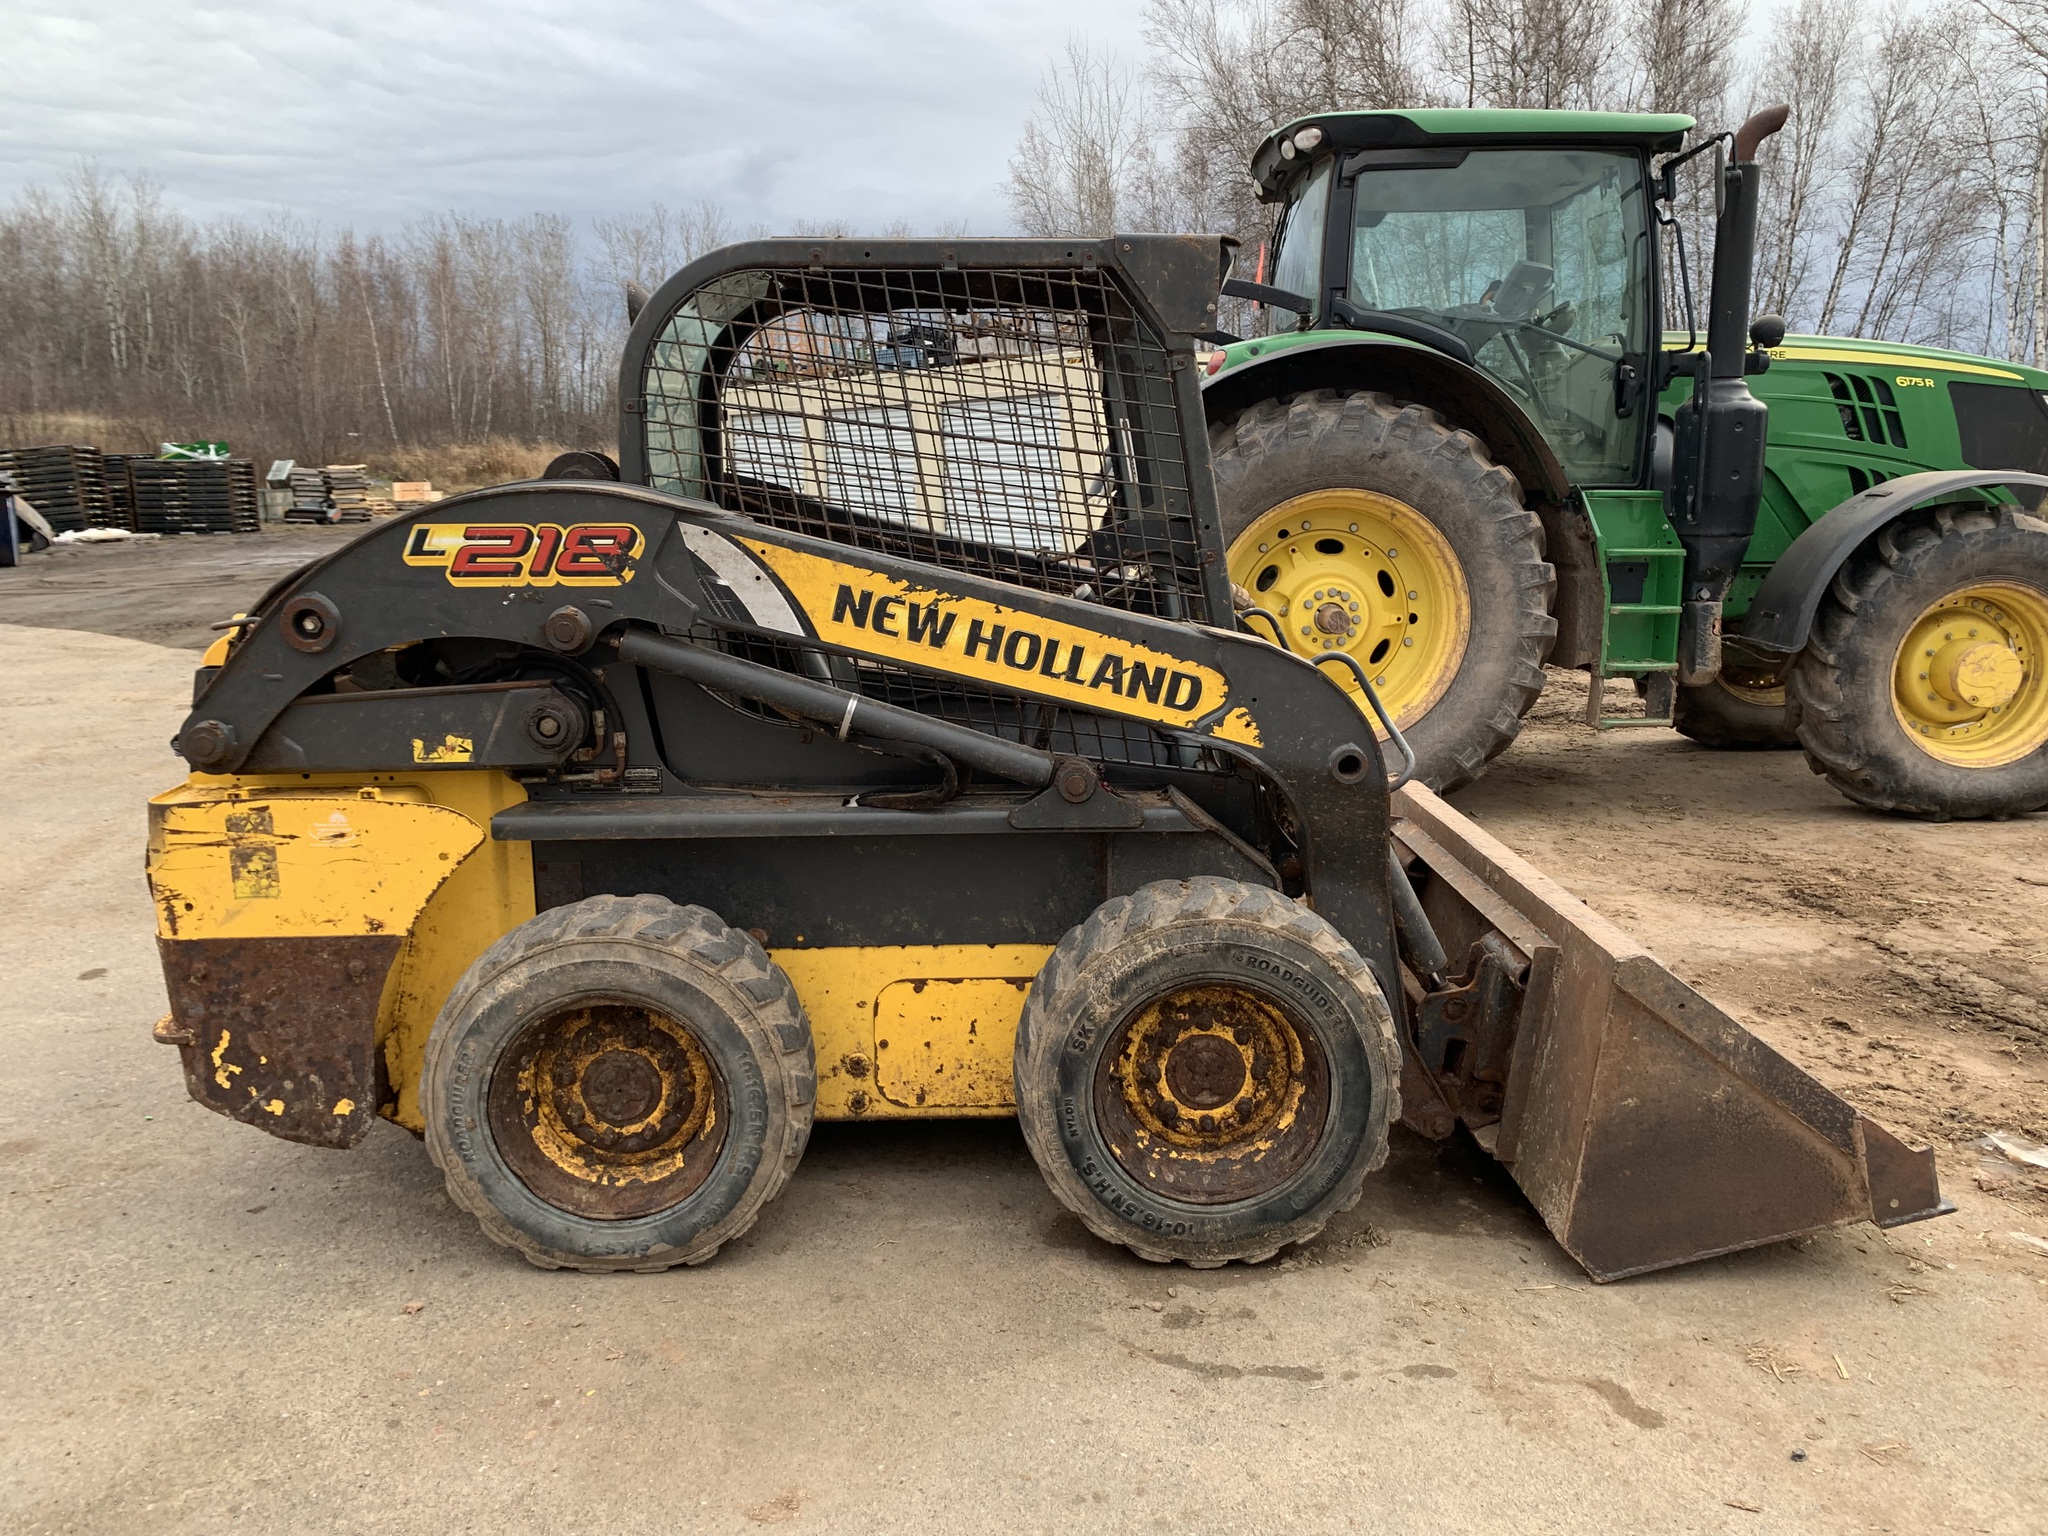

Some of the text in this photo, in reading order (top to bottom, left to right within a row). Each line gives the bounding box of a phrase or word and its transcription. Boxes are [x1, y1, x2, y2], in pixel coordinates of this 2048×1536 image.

[832, 583, 1204, 714] NEW HOLLAND
[1244, 952, 1344, 1030] ROADGUIDER
[1061, 1095, 1081, 1139] NYLON
